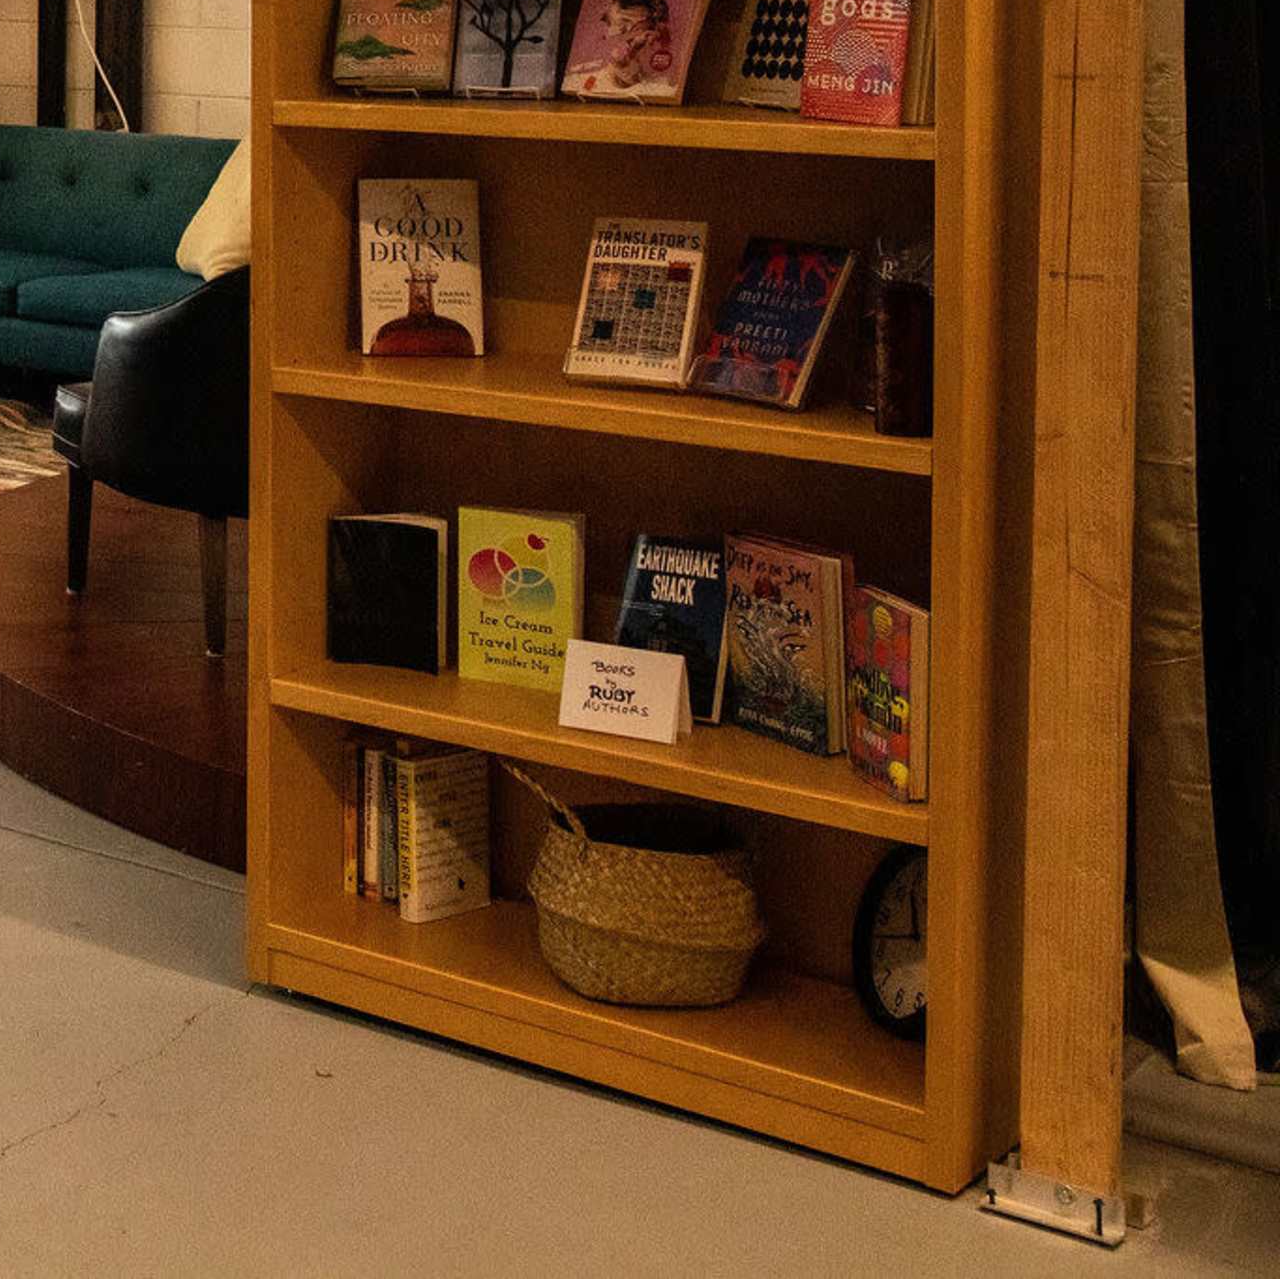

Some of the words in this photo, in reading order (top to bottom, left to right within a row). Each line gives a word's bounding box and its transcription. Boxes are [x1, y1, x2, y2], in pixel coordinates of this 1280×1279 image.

[806, 73, 857, 92] MENG
[860, 77, 895, 95] JIN
[373, 216, 463, 239] GOOD
[369, 241, 470, 262] DRINK
[597, 230, 702, 251] TRANSLATOR'S
[593, 244, 668, 262] DAUGHTER
[637, 542, 722, 580] EARTHQUAKE
[650, 573, 697, 607] SHACK
[479, 611, 499, 626] Ice
[503, 615, 554, 635] Cream
[468, 631, 518, 651] Travel
[521, 639, 566, 658] Guide
[484, 652, 528, 669] Jennifer
[531, 659, 550, 674] Ng
[588, 684, 636, 704] RUBY
[582, 698, 649, 717] AUTHORS
[399, 817, 411, 855] TITLE
[400, 856, 411, 893] HERE
